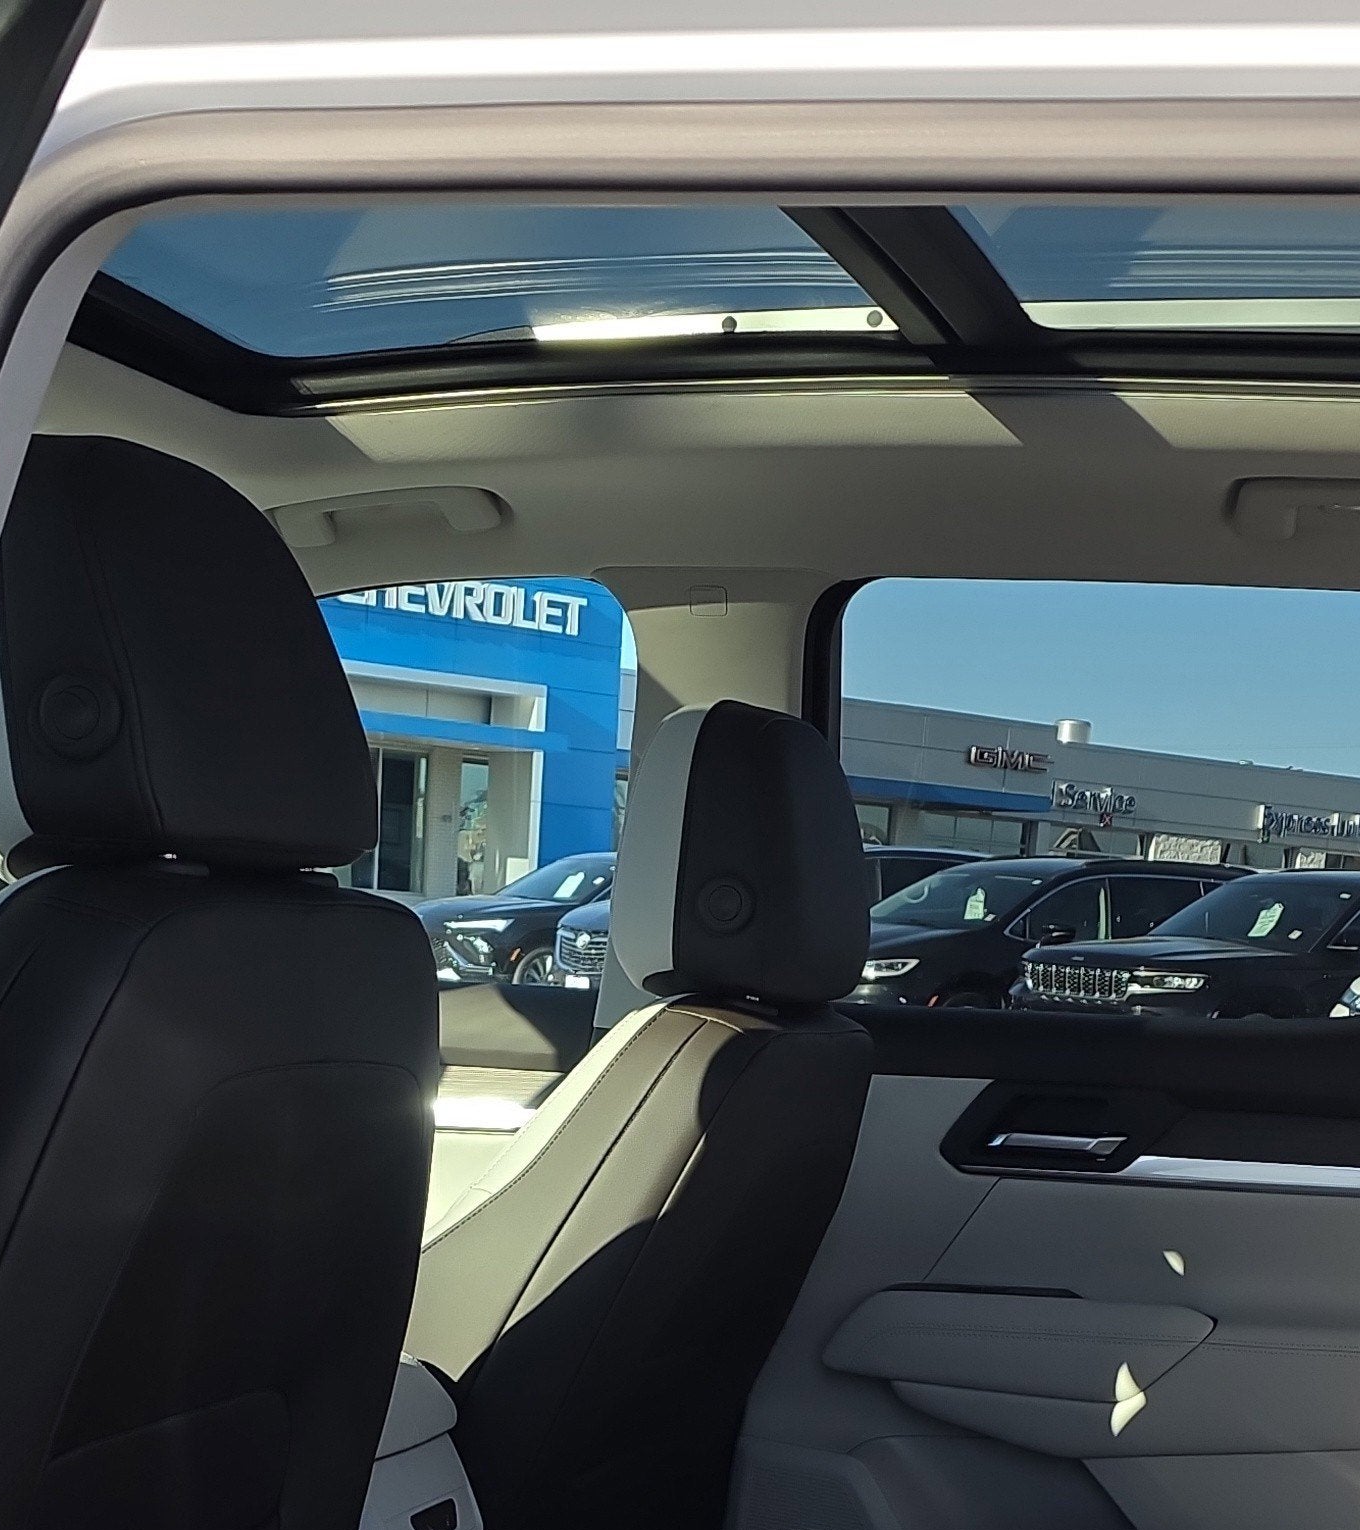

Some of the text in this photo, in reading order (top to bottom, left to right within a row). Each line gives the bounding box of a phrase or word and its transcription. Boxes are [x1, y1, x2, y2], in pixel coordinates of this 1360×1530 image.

[338, 580, 588, 636] EVROLET
[969, 745, 1054, 774] GMC
[1060, 783, 1137, 814] Service
